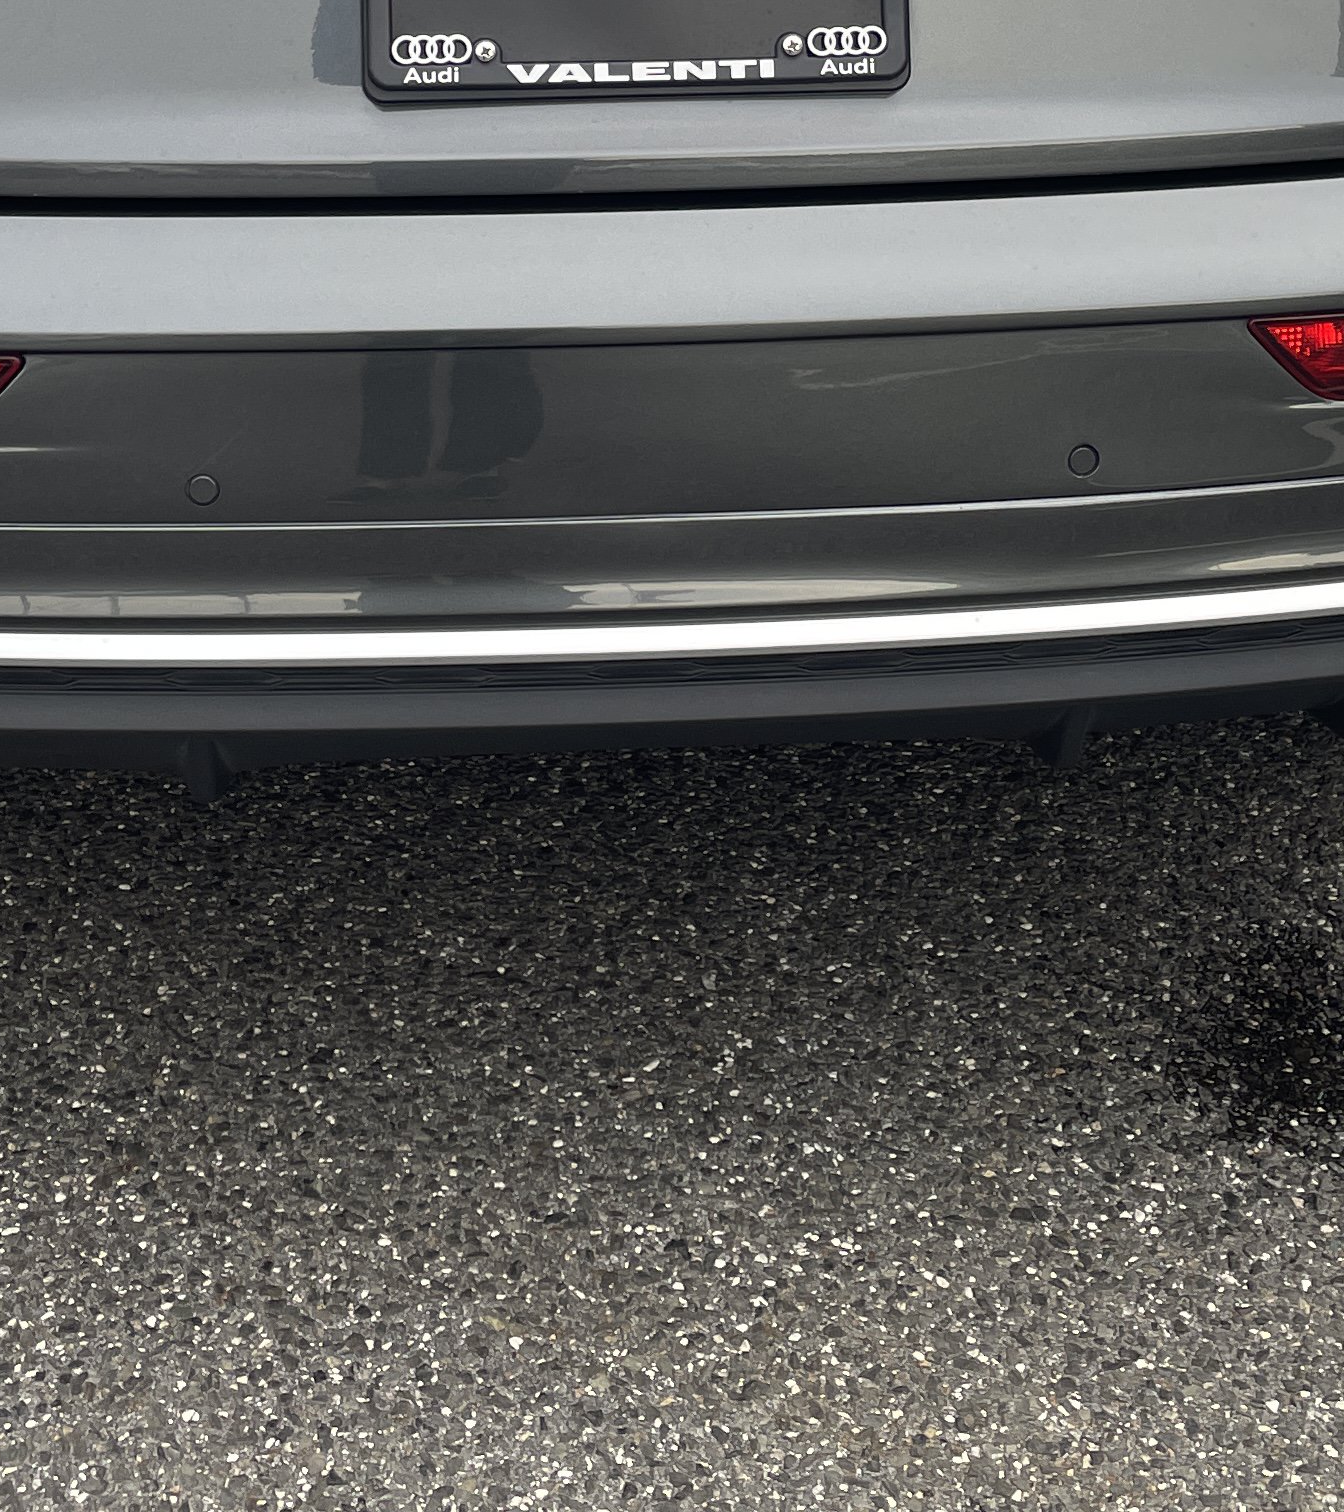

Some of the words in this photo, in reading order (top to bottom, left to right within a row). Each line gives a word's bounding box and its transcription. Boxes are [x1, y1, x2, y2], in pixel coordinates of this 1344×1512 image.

[402, 66, 461, 85] Audi
[505, 58, 775, 84] VALENTI
[820, 57, 876, 76] Audi
